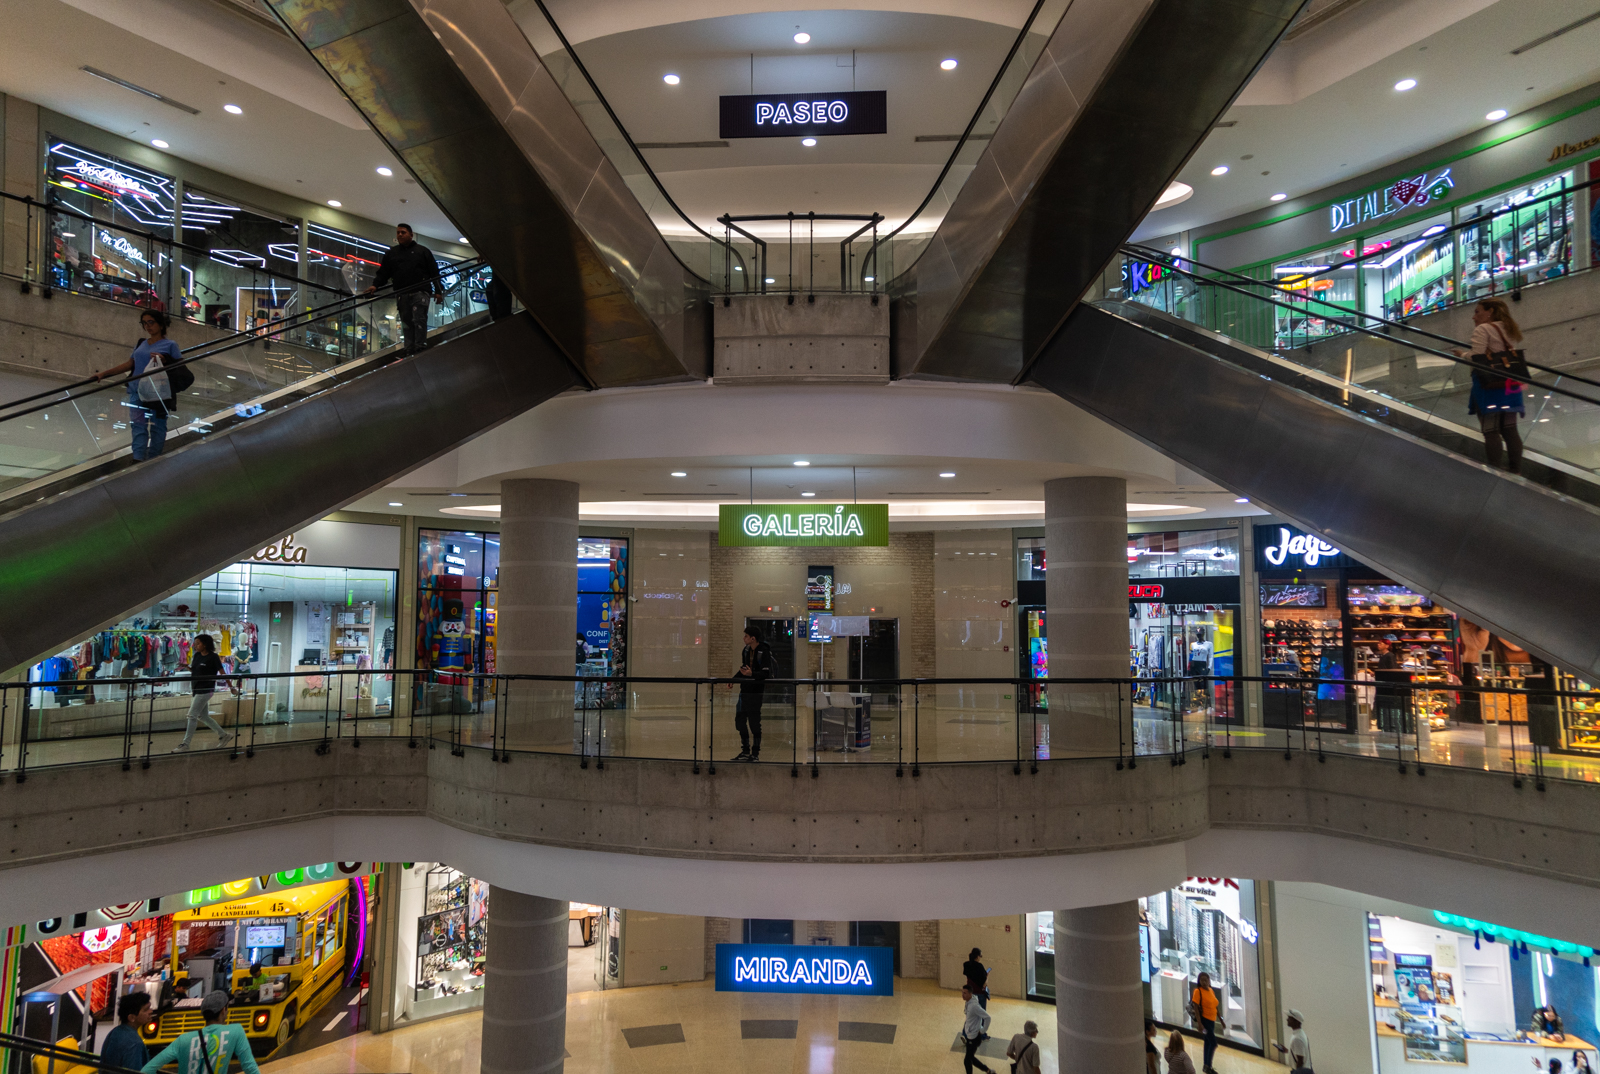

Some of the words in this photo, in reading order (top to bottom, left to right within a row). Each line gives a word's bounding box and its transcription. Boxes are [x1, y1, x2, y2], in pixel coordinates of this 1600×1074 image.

[756, 100, 848, 125] PASEO
[743, 505, 864, 536] GALERÍA
[1185, 885, 1196, 893] su
[1196, 887, 1217, 897] vista
[220, 909, 260, 917] CANDELARIA
[270, 902, 285, 913] 45
[735, 956, 873, 986] MIRANDA
